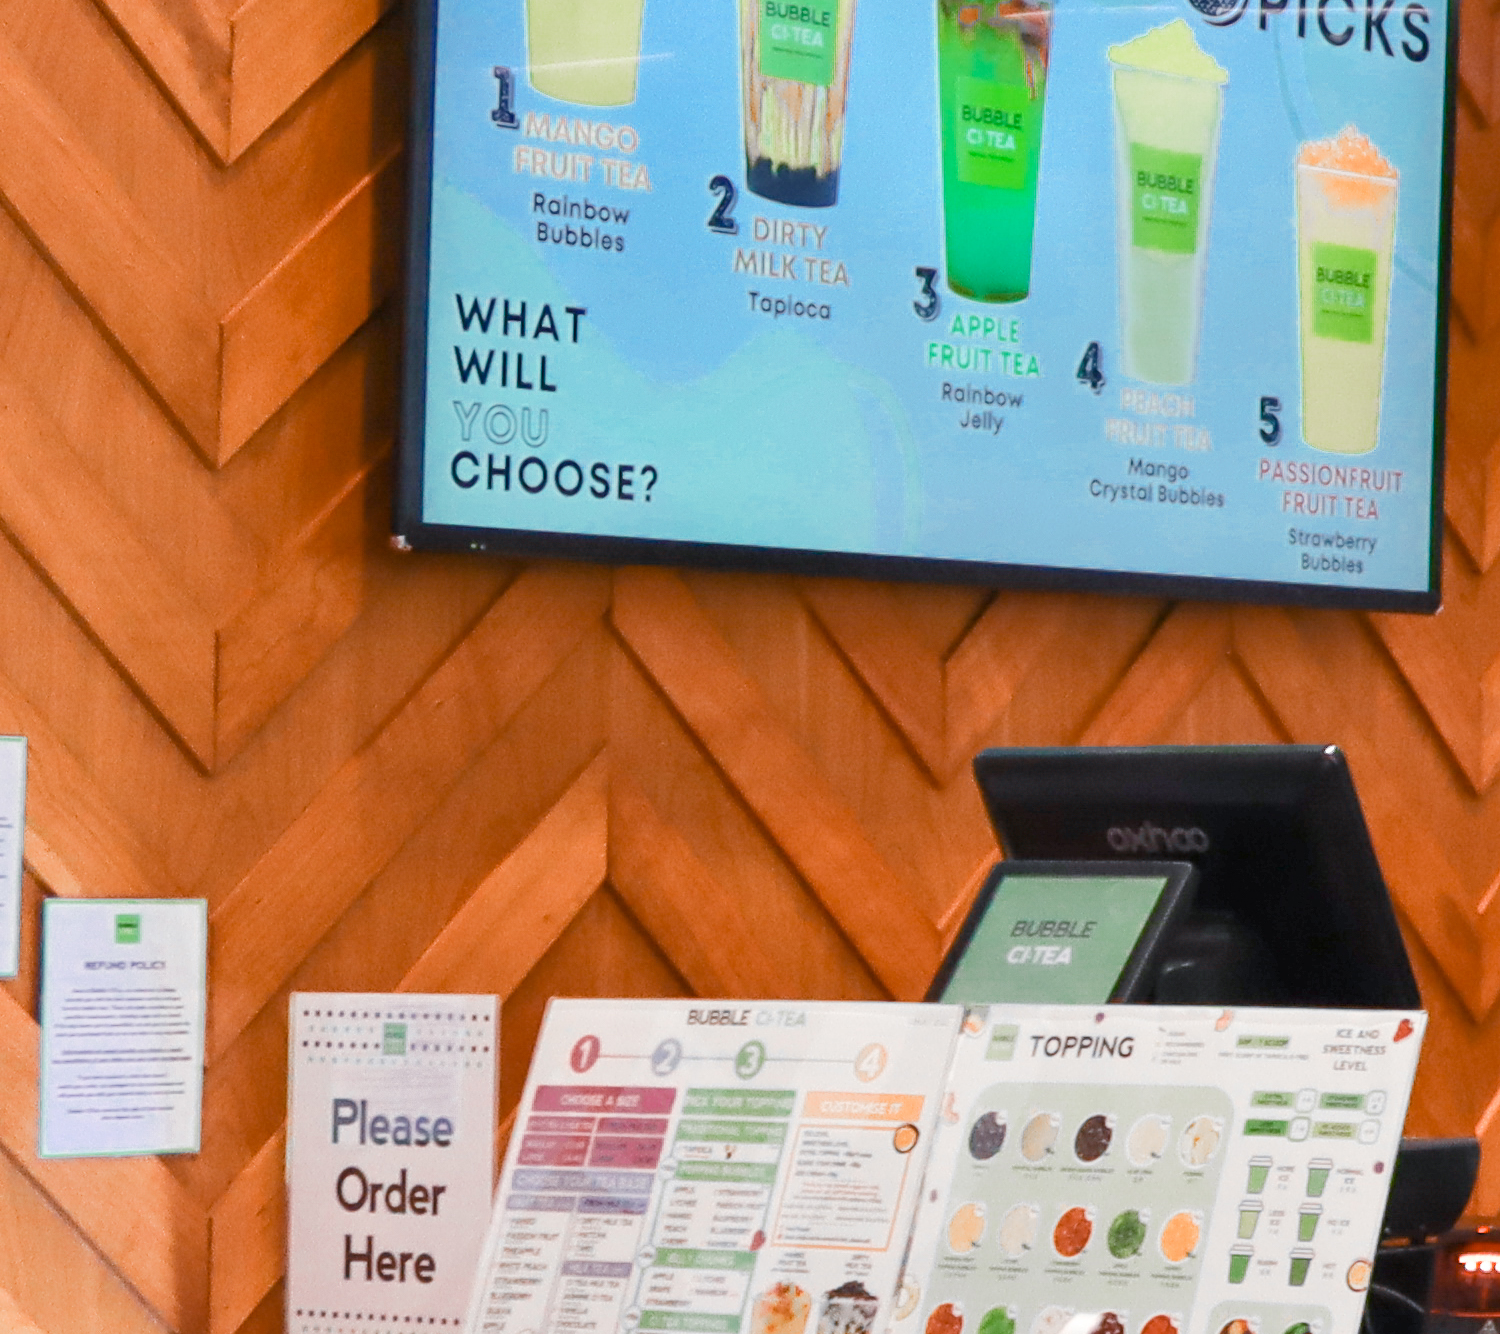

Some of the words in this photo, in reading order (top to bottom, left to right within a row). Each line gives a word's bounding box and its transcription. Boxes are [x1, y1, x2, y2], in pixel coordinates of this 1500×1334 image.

[491, 66, 520, 130] 1
[525, 112, 639, 153] MANGO
[515, 147, 593, 183] FRUIT
[601, 158, 652, 191] TEA
[534, 192, 630, 224] Rainbow
[708, 175, 738, 235] 2
[753, 217, 828, 249] DIRTY
[537, 222, 625, 252] Bubbles
[735, 248, 796, 281] MILK
[806, 258, 849, 286] TEA
[455, 293, 587, 343] WHAT
[749, 290, 831, 321] Tapioca
[914, 267, 940, 322] 3
[950, 313, 1020, 343] APPLE
[454, 346, 556, 392] WILL
[929, 341, 992, 371] FRUIT
[1001, 350, 1040, 376] TEA
[1075, 342, 1106, 395] 4
[942, 382, 1024, 408] Rainbow
[453, 401, 548, 447] YOU
[960, 412, 1004, 436] Jelly
[1259, 396, 1282, 446] 5
[450, 451, 658, 502] CHOOSE?
[1128, 459, 1189, 481] Mango
[1259, 460, 1403, 493] PASSIONFRUIT
[1090, 479, 1153, 502] Crystal
[1158, 485, 1225, 507] Bubbles
[1282, 492, 1337, 516] FRUIT
[1345, 496, 1380, 519] TEA
[1289, 528, 1377, 552] Strawberry
[1301, 552, 1364, 574] Bubbles
[1010, 921, 1097, 938] BUBBLE
[687, 1009, 750, 1026] BUBBLE
[1030, 1035, 1135, 1058] TOPPING
[1323, 1045, 1386, 1054] SWEETNESS
[1333, 1061, 1367, 1071] LEVEL
[331, 1097, 454, 1148] Please
[336, 1167, 446, 1217] Order
[344, 1235, 436, 1284] Here
